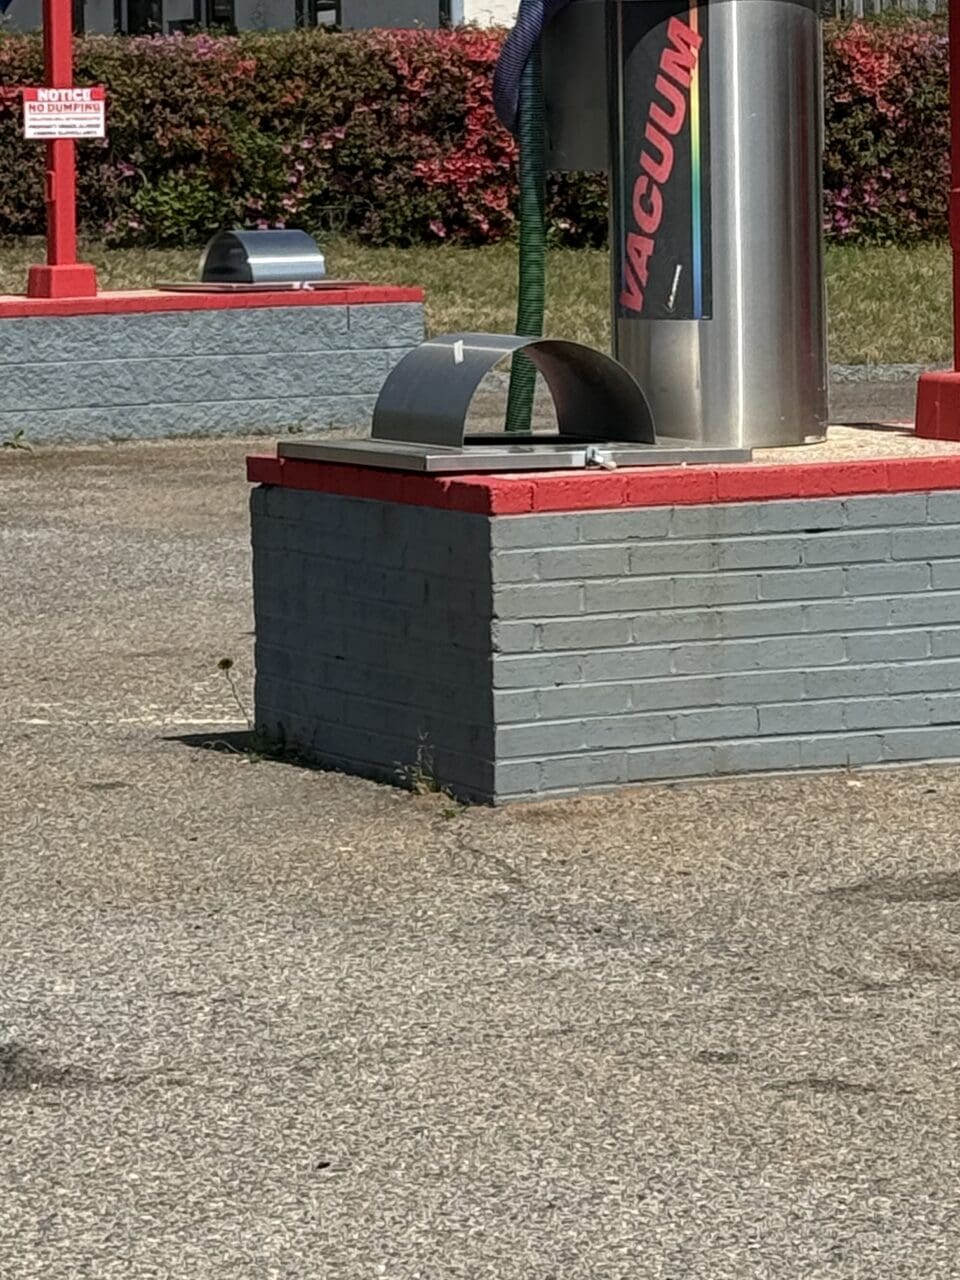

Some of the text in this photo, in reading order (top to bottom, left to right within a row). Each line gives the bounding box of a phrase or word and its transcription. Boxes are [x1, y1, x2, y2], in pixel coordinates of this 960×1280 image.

[37, 88, 92, 101] NOTICE
[28, 103, 100, 112] NO DUMPING
[620, 16, 703, 312] VACUUM
